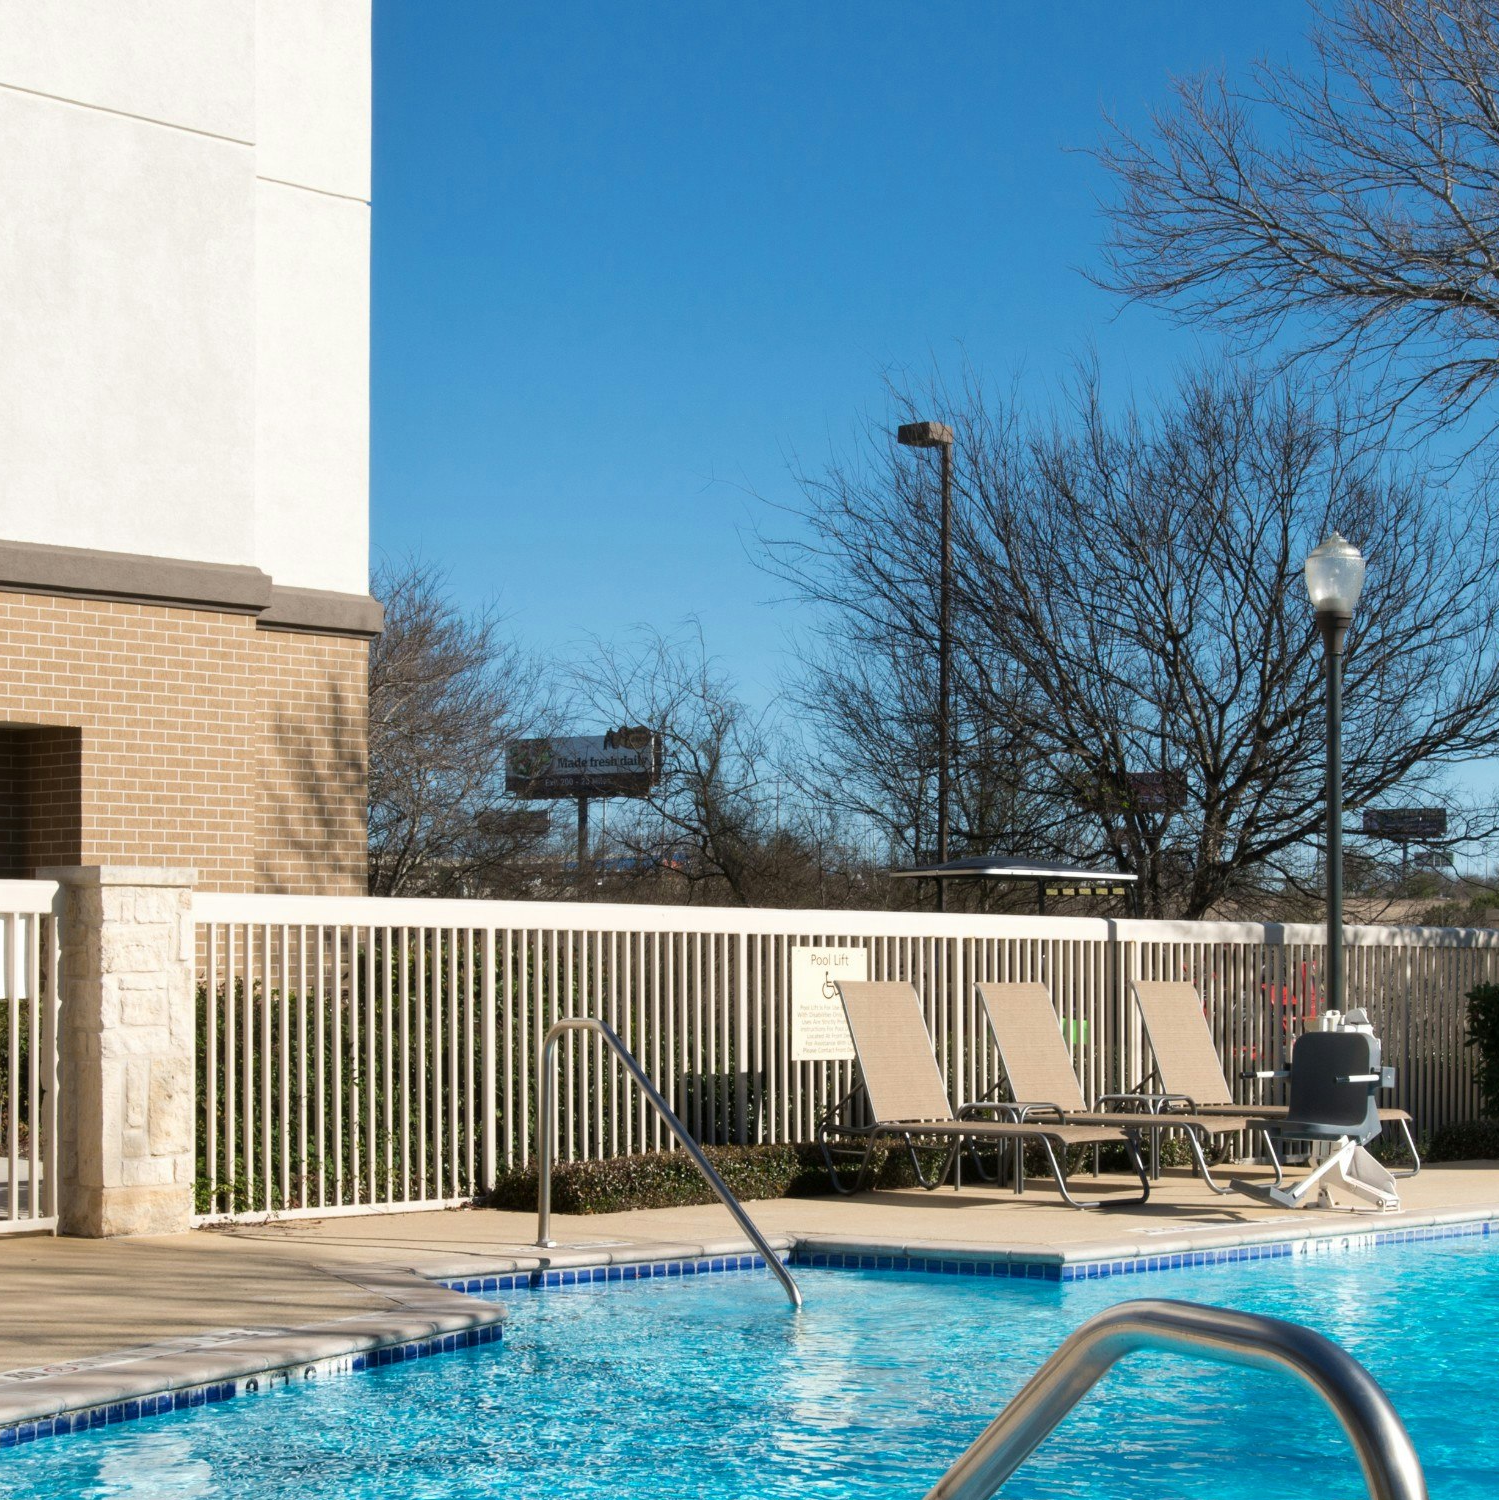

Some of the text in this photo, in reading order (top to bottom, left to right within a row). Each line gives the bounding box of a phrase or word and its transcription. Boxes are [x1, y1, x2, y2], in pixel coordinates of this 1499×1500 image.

[557, 754, 648, 769] Made fresh daily
[811, 953, 849, 966] Pool Lift
